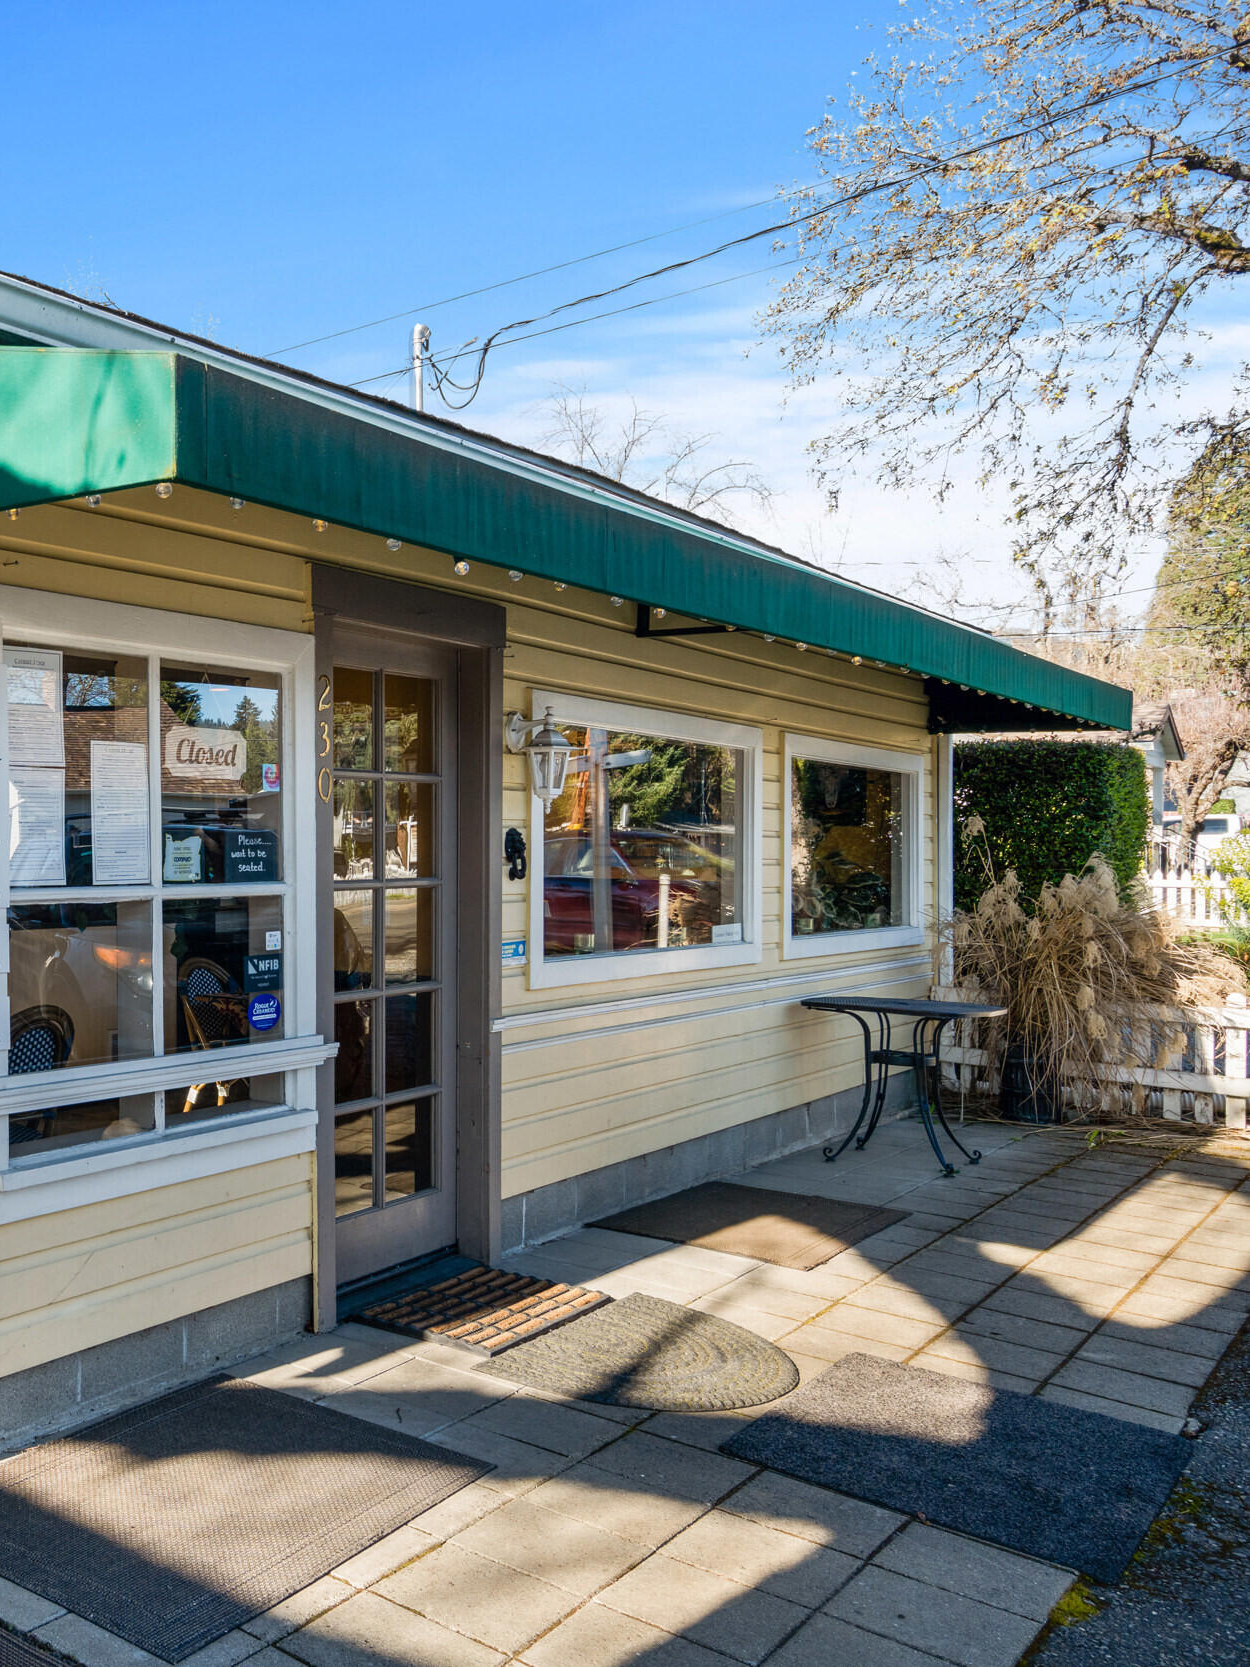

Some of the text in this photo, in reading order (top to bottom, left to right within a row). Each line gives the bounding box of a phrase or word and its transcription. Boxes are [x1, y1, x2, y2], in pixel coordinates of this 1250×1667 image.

[318, 674, 333, 804] 230
[175, 737, 239, 768] Closed
[230, 848, 267, 858] wait to be
[258, 959, 279, 971] NFIB
